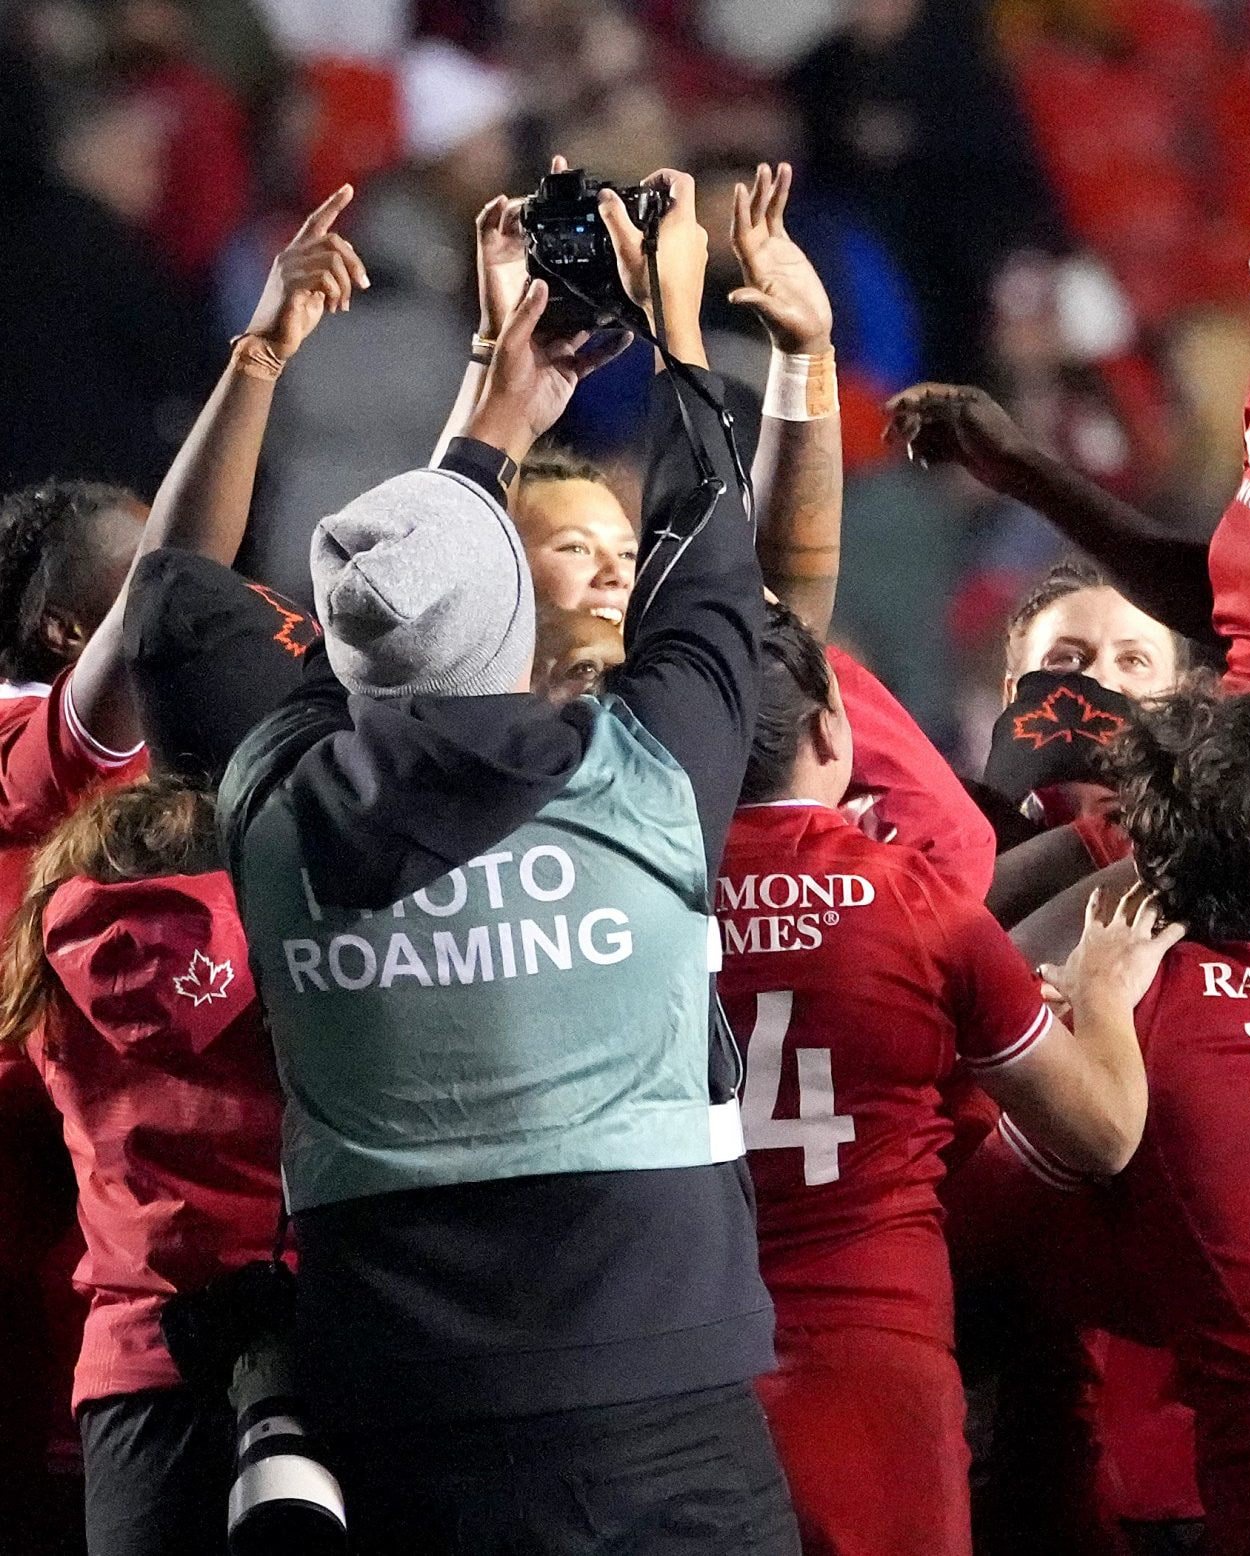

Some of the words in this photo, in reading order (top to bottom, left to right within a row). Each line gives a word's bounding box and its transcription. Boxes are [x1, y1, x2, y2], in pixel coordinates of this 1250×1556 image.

[716, 873, 875, 912] MOND
[282, 907, 633, 993] ROAMING
[721, 910, 839, 955] MES®
